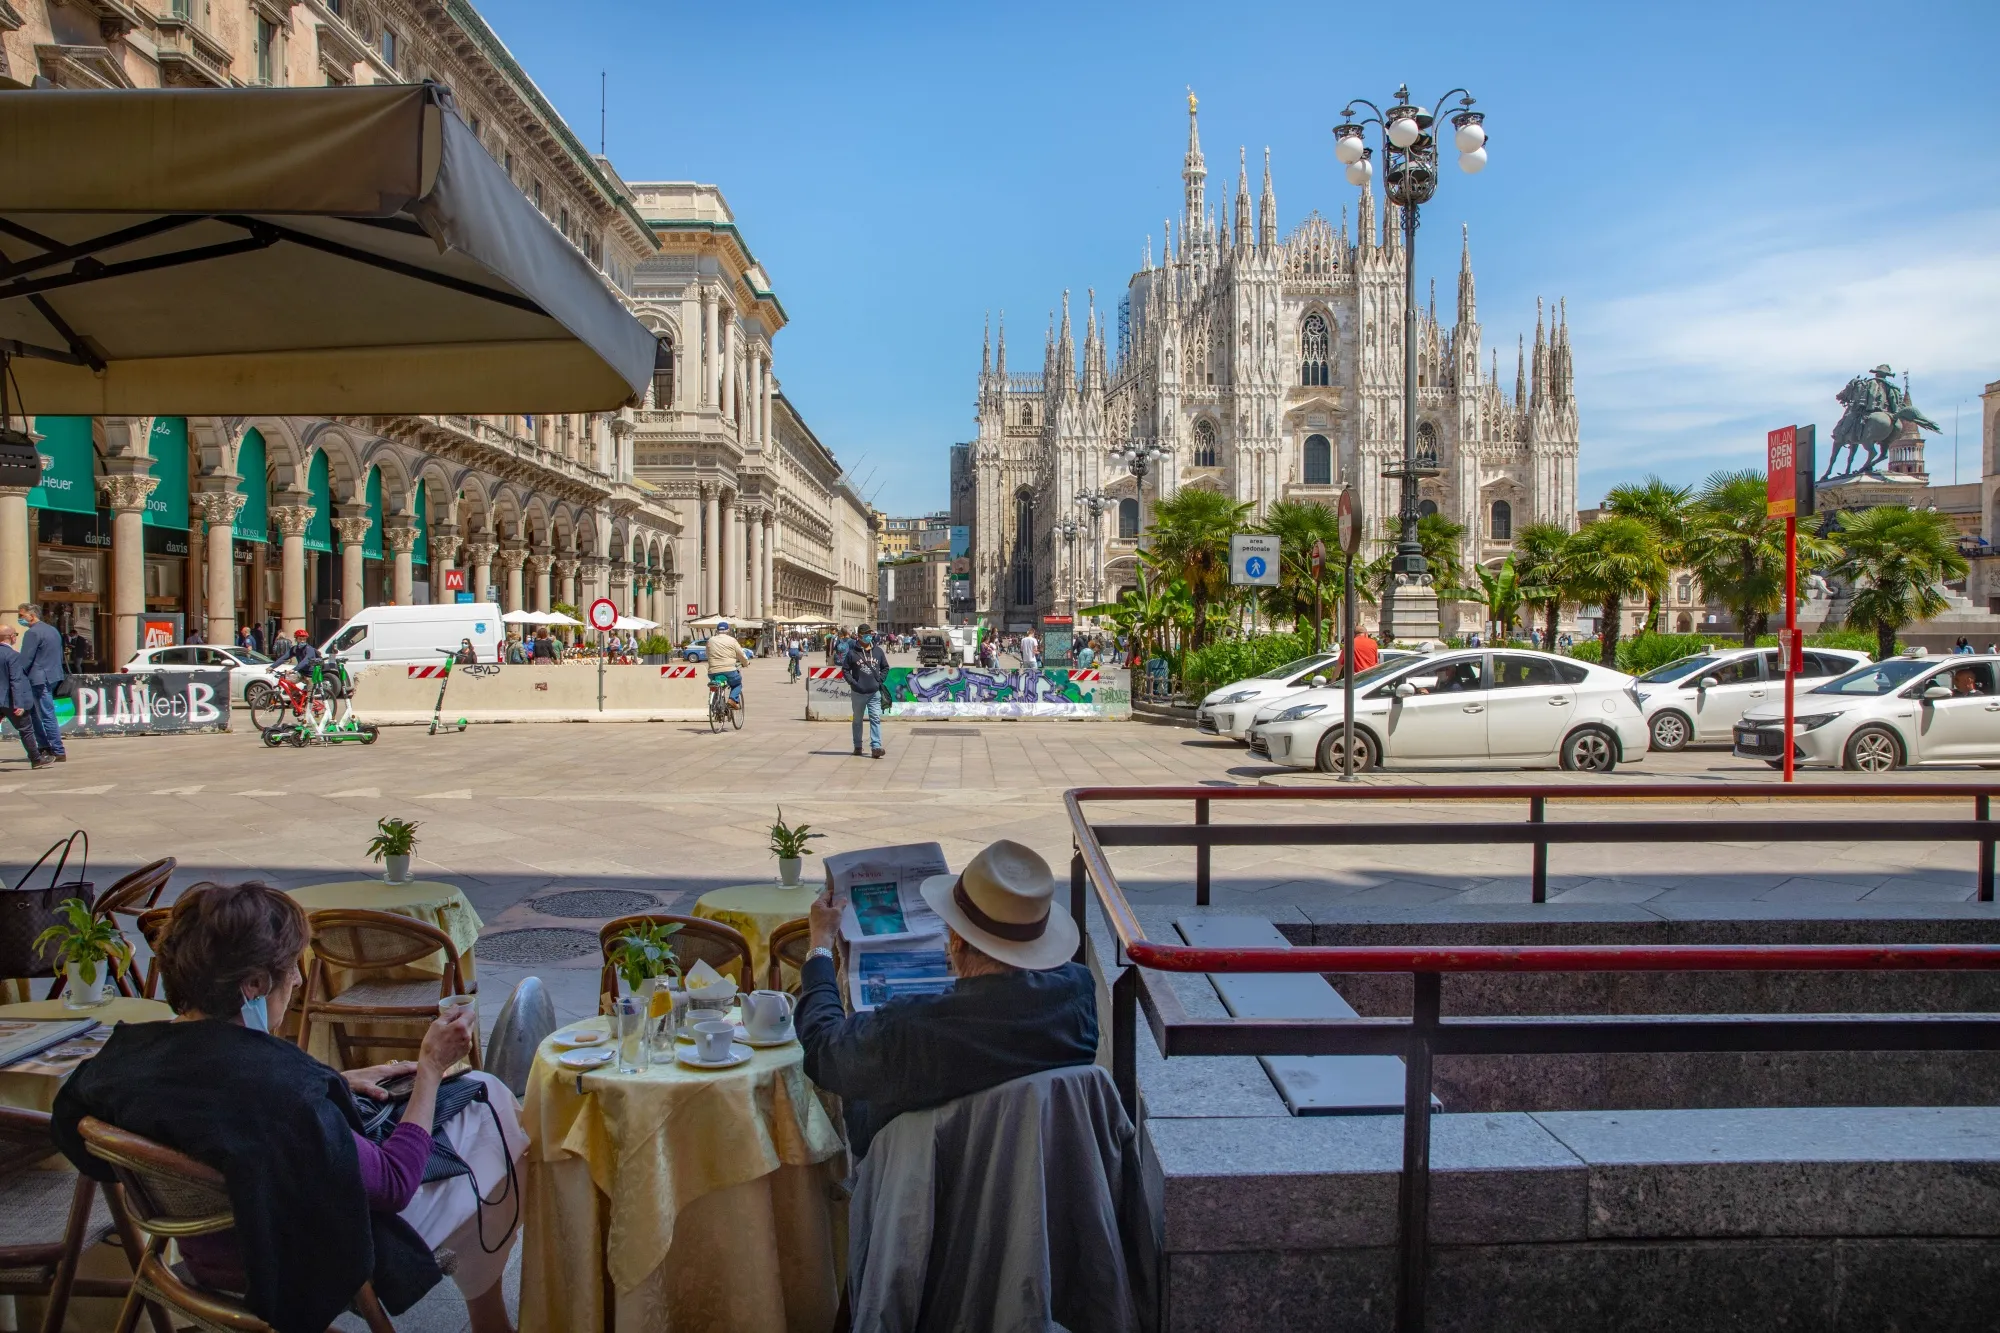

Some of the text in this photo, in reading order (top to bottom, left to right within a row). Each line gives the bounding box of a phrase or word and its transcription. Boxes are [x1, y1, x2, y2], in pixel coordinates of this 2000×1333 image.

[1770, 430, 1793, 447] MILAN
[1770, 443, 1793, 459] OPEN
[1771, 456, 1792, 471] TOUR
[85, 532, 111, 546] davis
[242, 528, 259, 538] ROSSI
[166, 541, 188, 554] davis
[234, 548, 253, 560] davis
[447, 574, 463, 586] M
